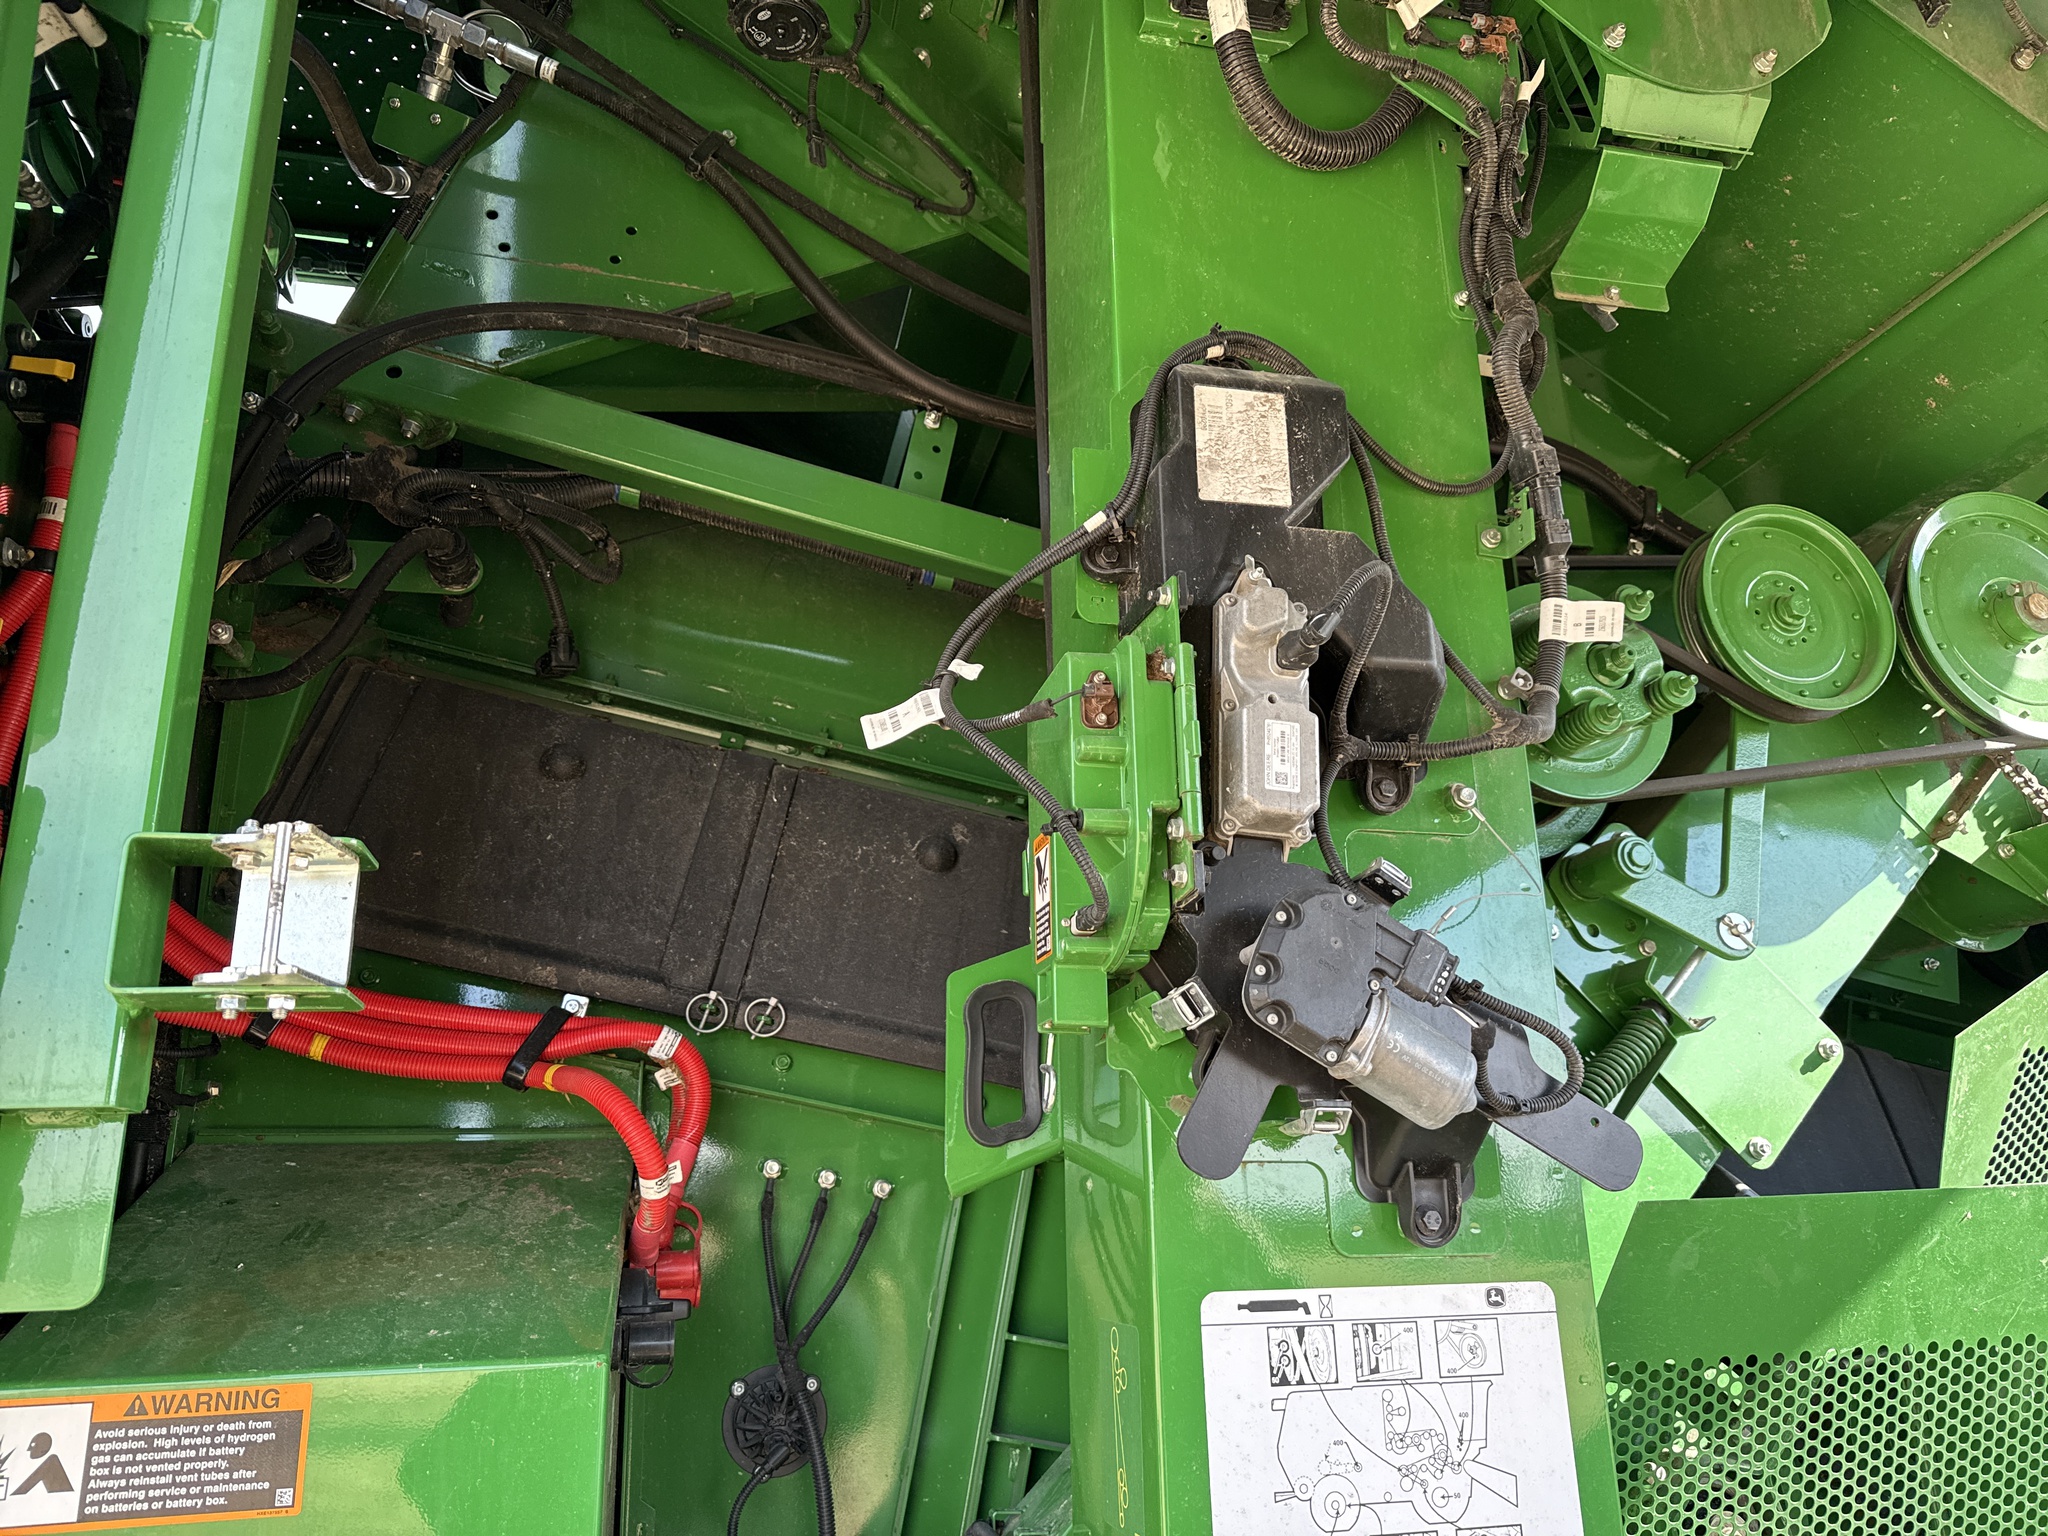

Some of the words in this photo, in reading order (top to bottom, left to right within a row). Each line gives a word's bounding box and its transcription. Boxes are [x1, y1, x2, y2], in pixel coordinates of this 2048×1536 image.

[151, 1388, 280, 1415] WARNING
[95, 1428, 126, 1439] Avoid
[128, 1425, 167, 1437] serious
[170, 1422, 200, 1435] injury
[203, 1423, 214, 1432] or
[217, 1420, 245, 1431] death
[248, 1419, 271, 1429] from
[93, 1440, 147, 1452] explosion.
[153, 1437, 178, 1450] High
[181, 1434, 211, 1445] levels
[214, 1433, 225, 1443] of
[227, 1431, 275, 1444] hydrogen
[92, 1454, 111, 1465] gas
[113, 1452, 133, 1462] can
[135, 1449, 196, 1461] accumulate
[199, 1447, 206, 1457] if
[208, 1445, 245, 1458] battery
[89, 1465, 109, 1476] box
[112, 1465, 122, 1474] is
[125, 1464, 143, 1473] not
[146, 1461, 180, 1472] vented
[184, 1459, 229, 1472] properly.
[88, 1478, 126, 1491] Always
[129, 1474, 173, 1486] reinstall
[175, 1473, 198, 1483] vent
[201, 1470, 229, 1481] tubes
[233, 1469, 257, 1479] after
[86, 1489, 145, 1503] performing
[148, 1487, 186, 1498] service
[189, 1486, 201, 1495] or
[204, 1481, 269, 1493] maintenance
[84, 1505, 98, 1514] on
[101, 1501, 149, 1513] batteries
[152, 1501, 163, 1509] or
[166, 1498, 203, 1511] battery
[205, 1495, 228, 1506] box.
